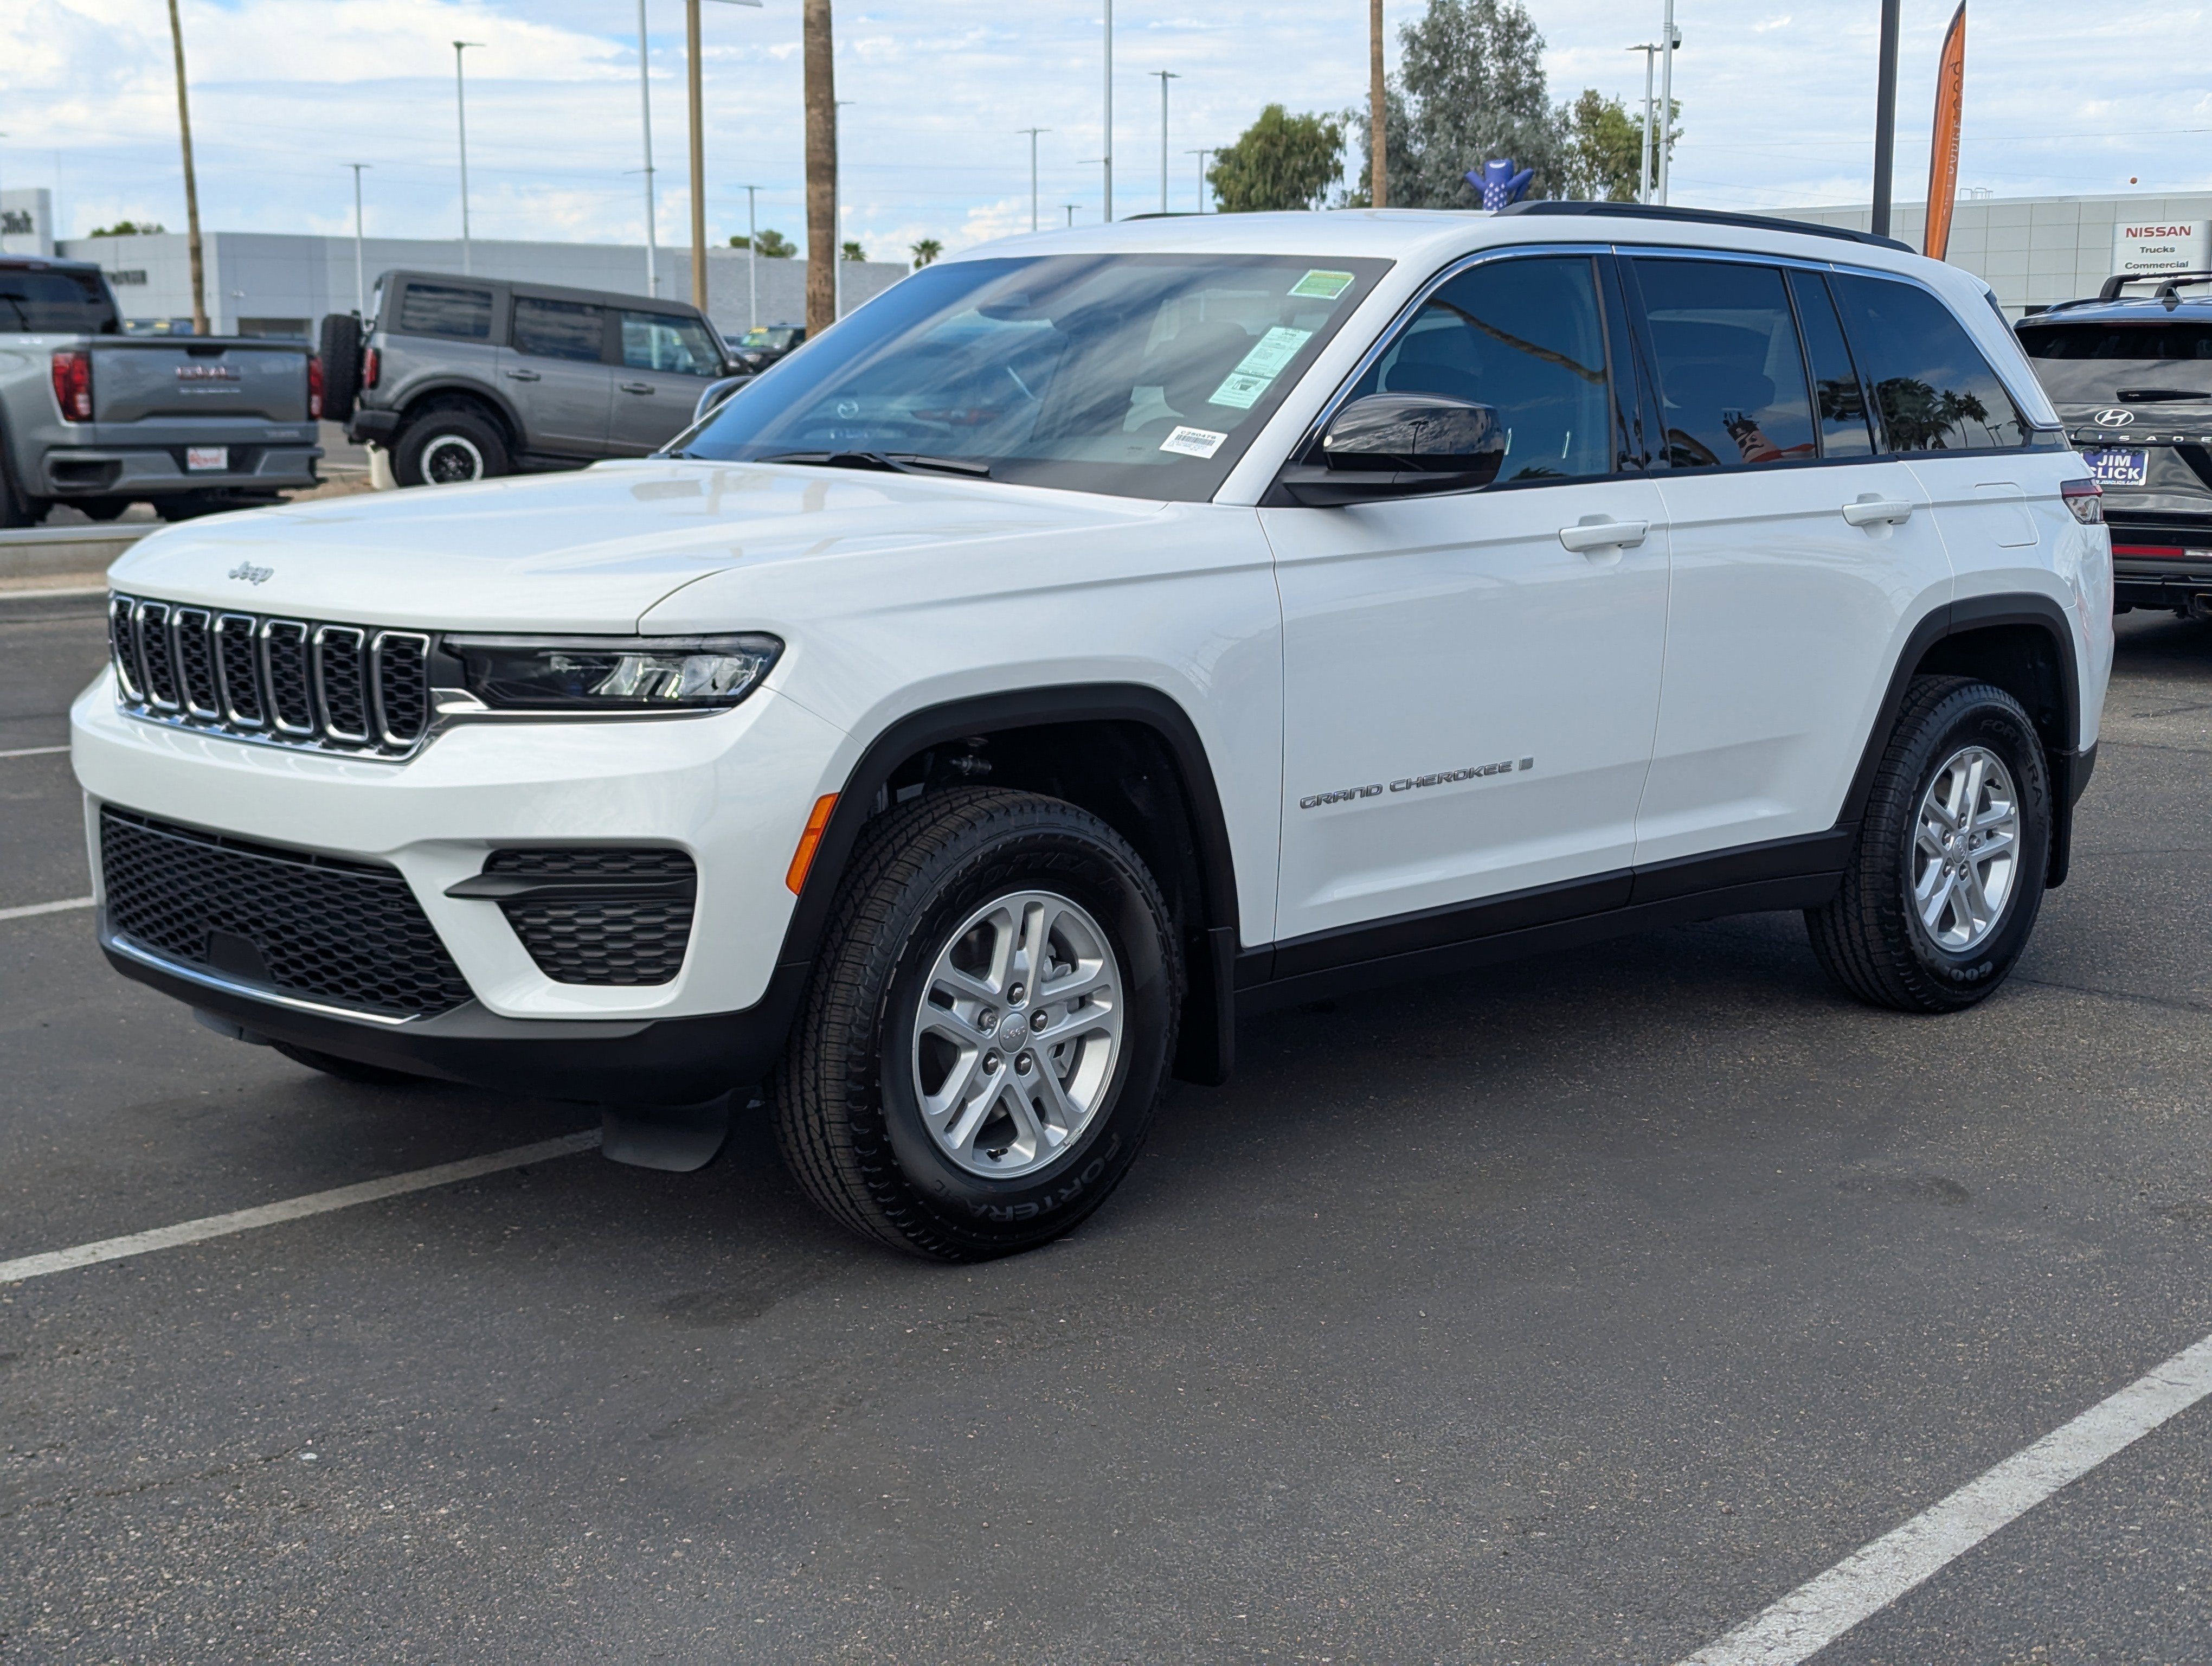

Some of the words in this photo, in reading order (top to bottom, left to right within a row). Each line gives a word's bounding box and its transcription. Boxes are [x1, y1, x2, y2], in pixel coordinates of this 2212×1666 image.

[2126, 226, 2191, 238] NISSAN
[2125, 261, 2188, 269] Commercial
[2070, 434, 2212, 443] LISADE
[2097, 454, 2131, 466] JIM
[228, 561, 274, 586] Jeep
[1300, 784, 1383, 809] GRAND
[1390, 760, 1513, 792] CHEROKEE
